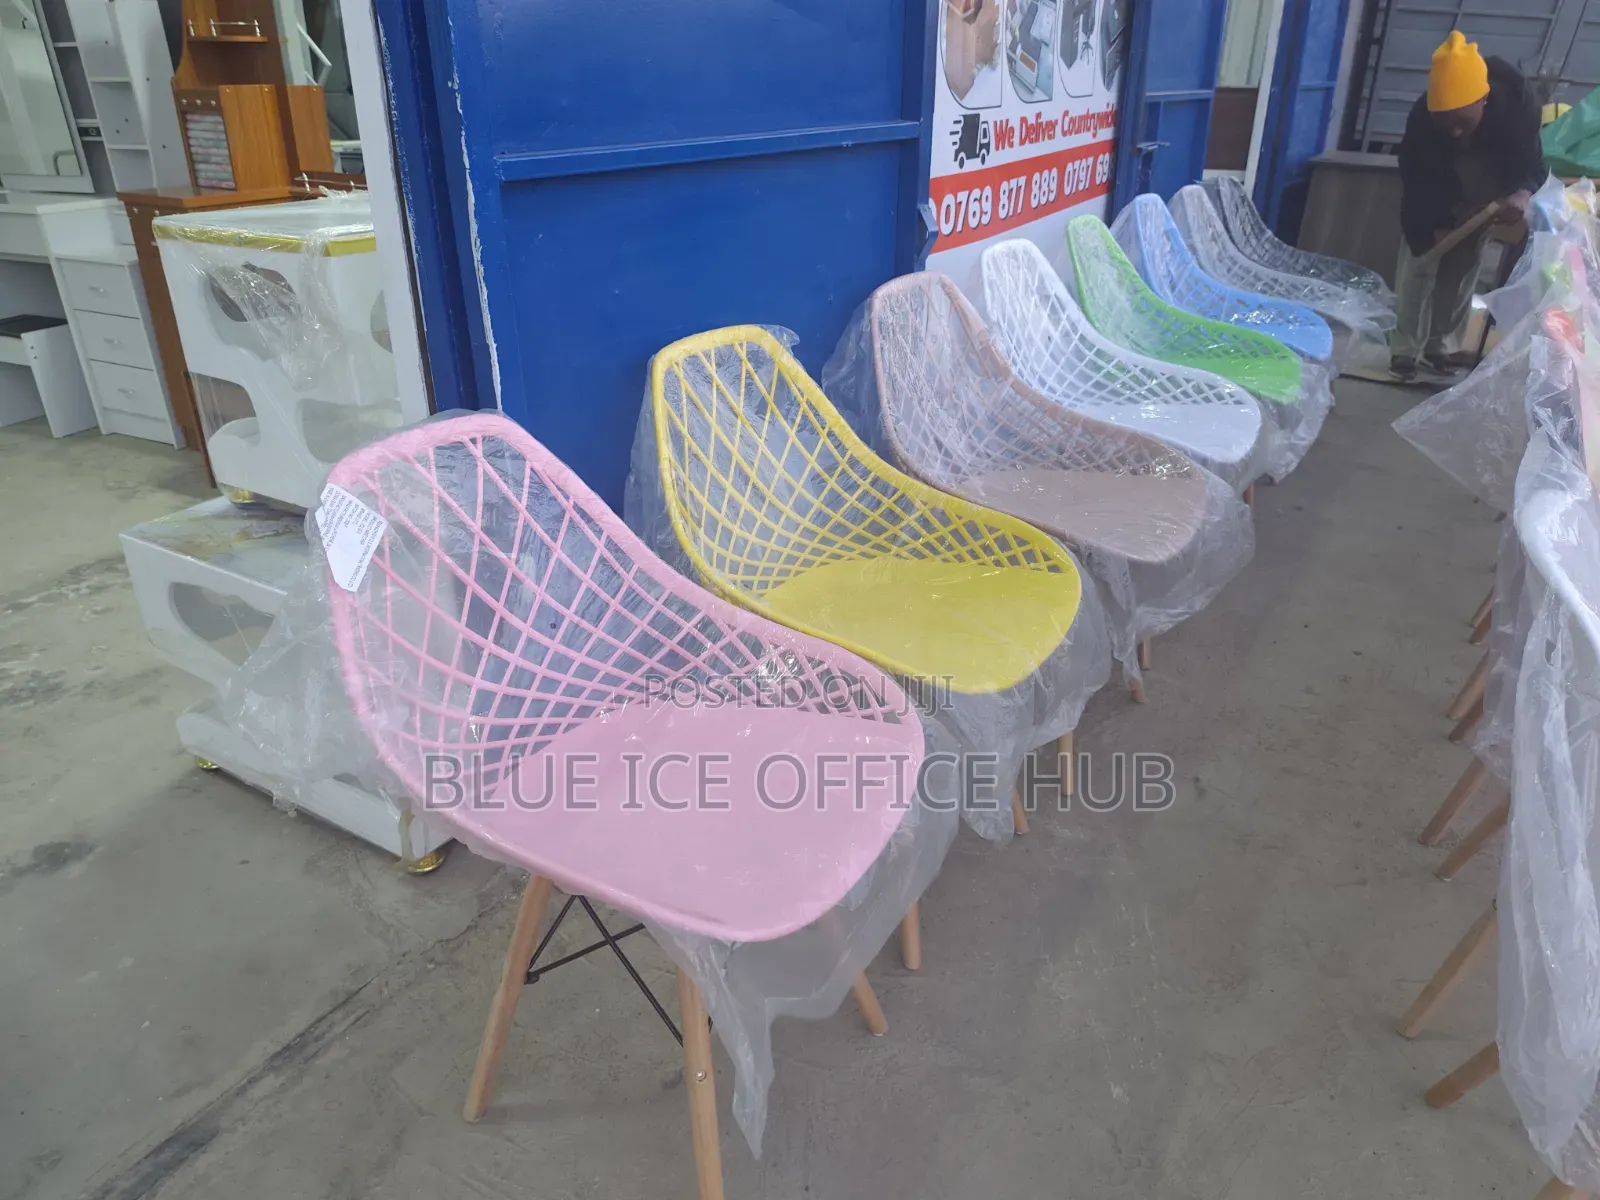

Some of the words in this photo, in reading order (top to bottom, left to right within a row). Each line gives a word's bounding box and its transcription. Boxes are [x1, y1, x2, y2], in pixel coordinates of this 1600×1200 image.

[993, 119, 1015, 151] We
[1018, 112, 1058, 146] Deliver
[940, 185, 993, 236] 0769
[998, 175, 1027, 220] 877
[1030, 167, 1058, 209] 889
[1064, 156, 1094, 196] 0797
